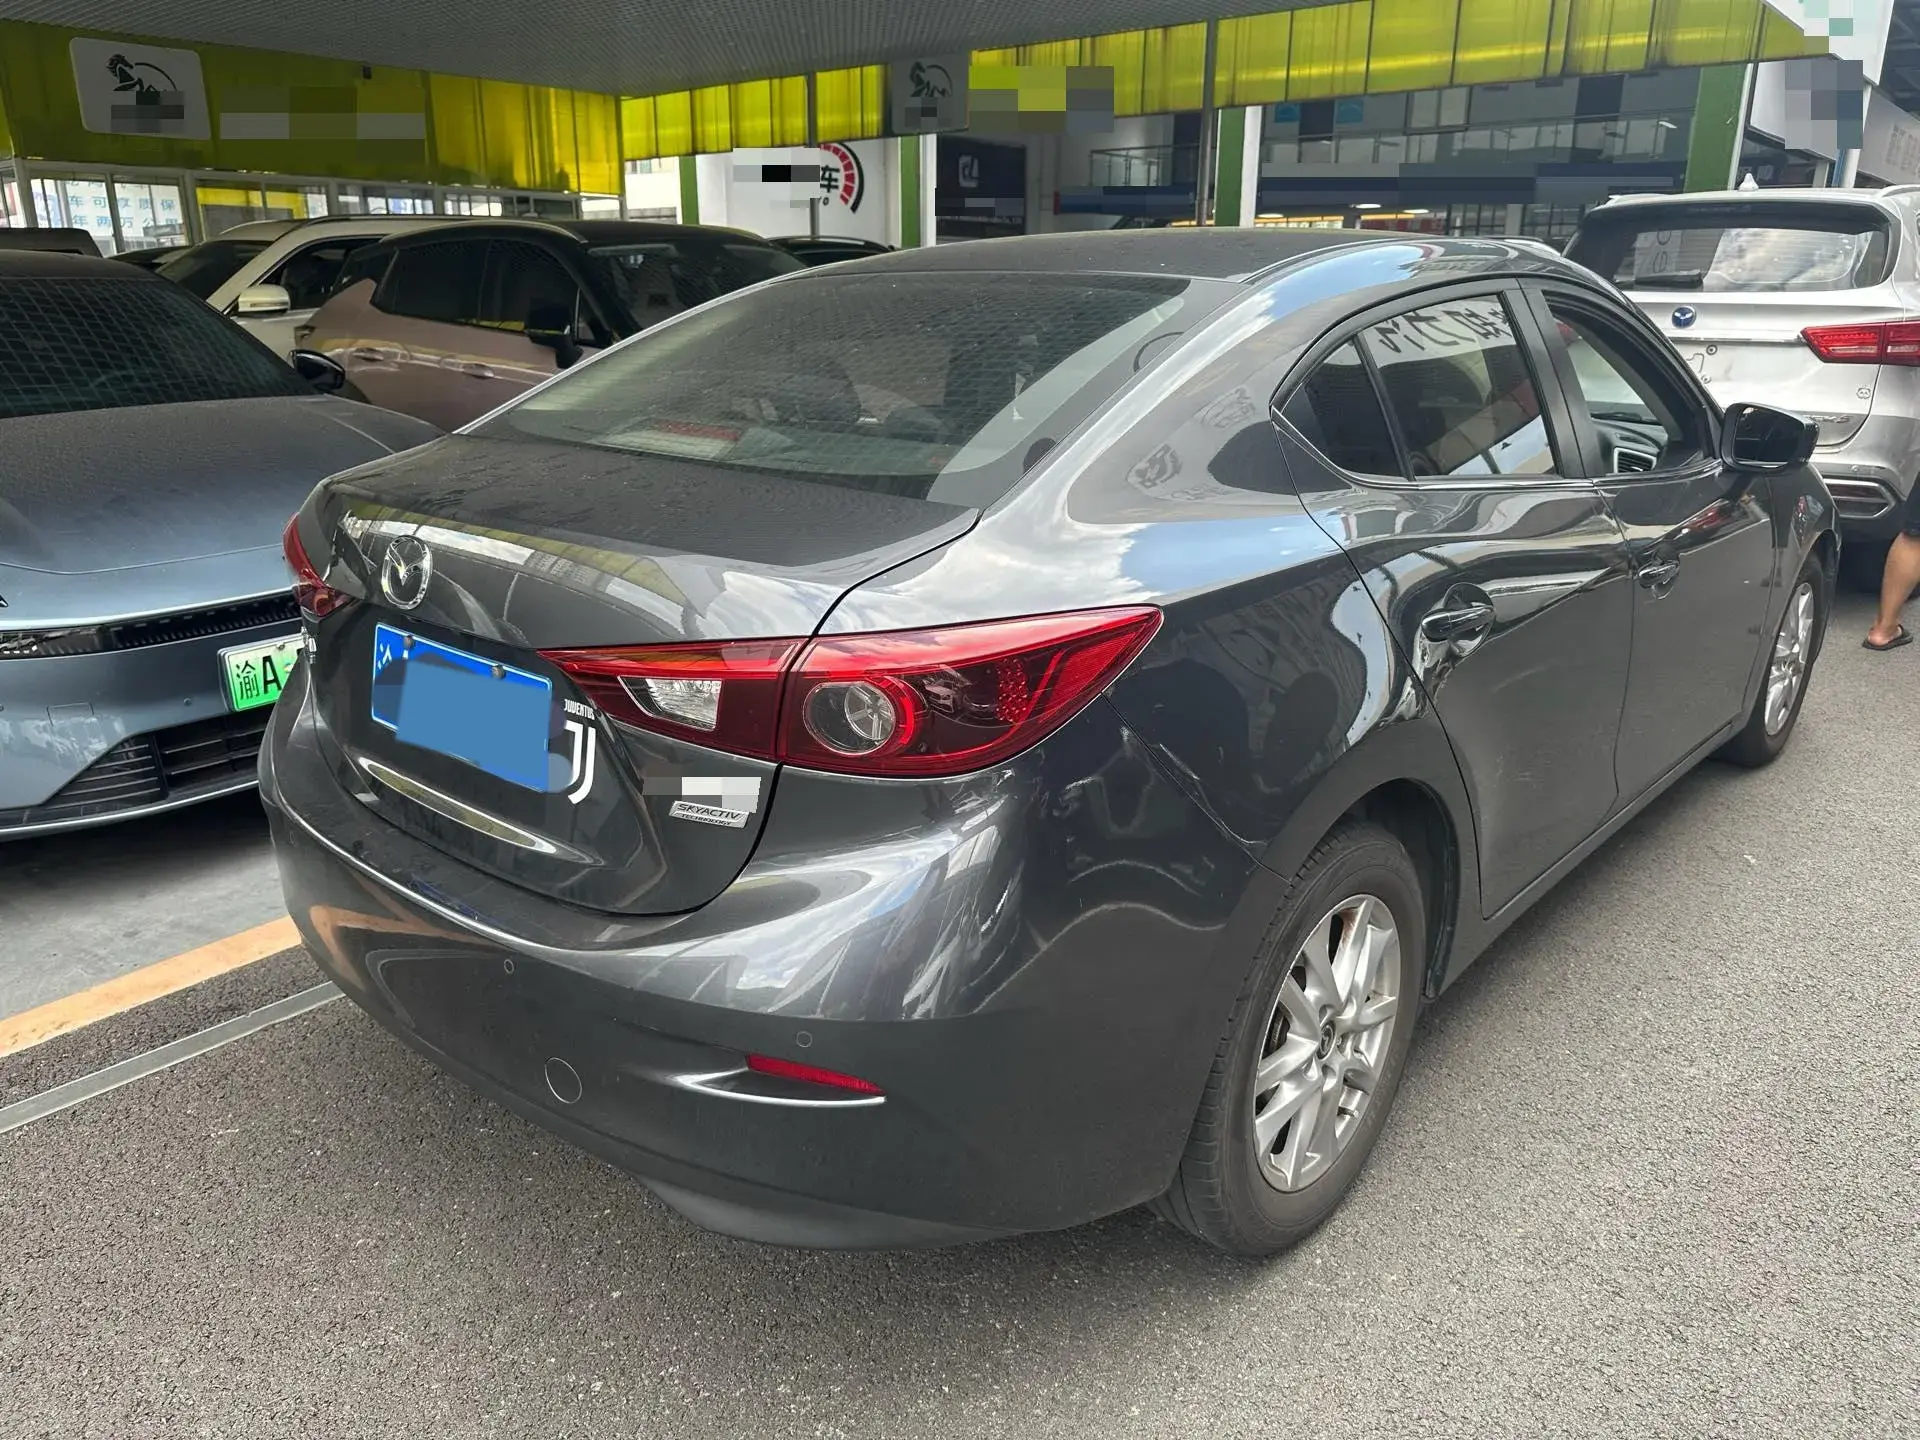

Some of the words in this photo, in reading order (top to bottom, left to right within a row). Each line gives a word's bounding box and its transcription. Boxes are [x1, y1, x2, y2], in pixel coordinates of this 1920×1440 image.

[820, 165, 840, 193] 车
[564, 698, 596, 720] JUVENTUS
[677, 803, 741, 820] SKYACTIV
